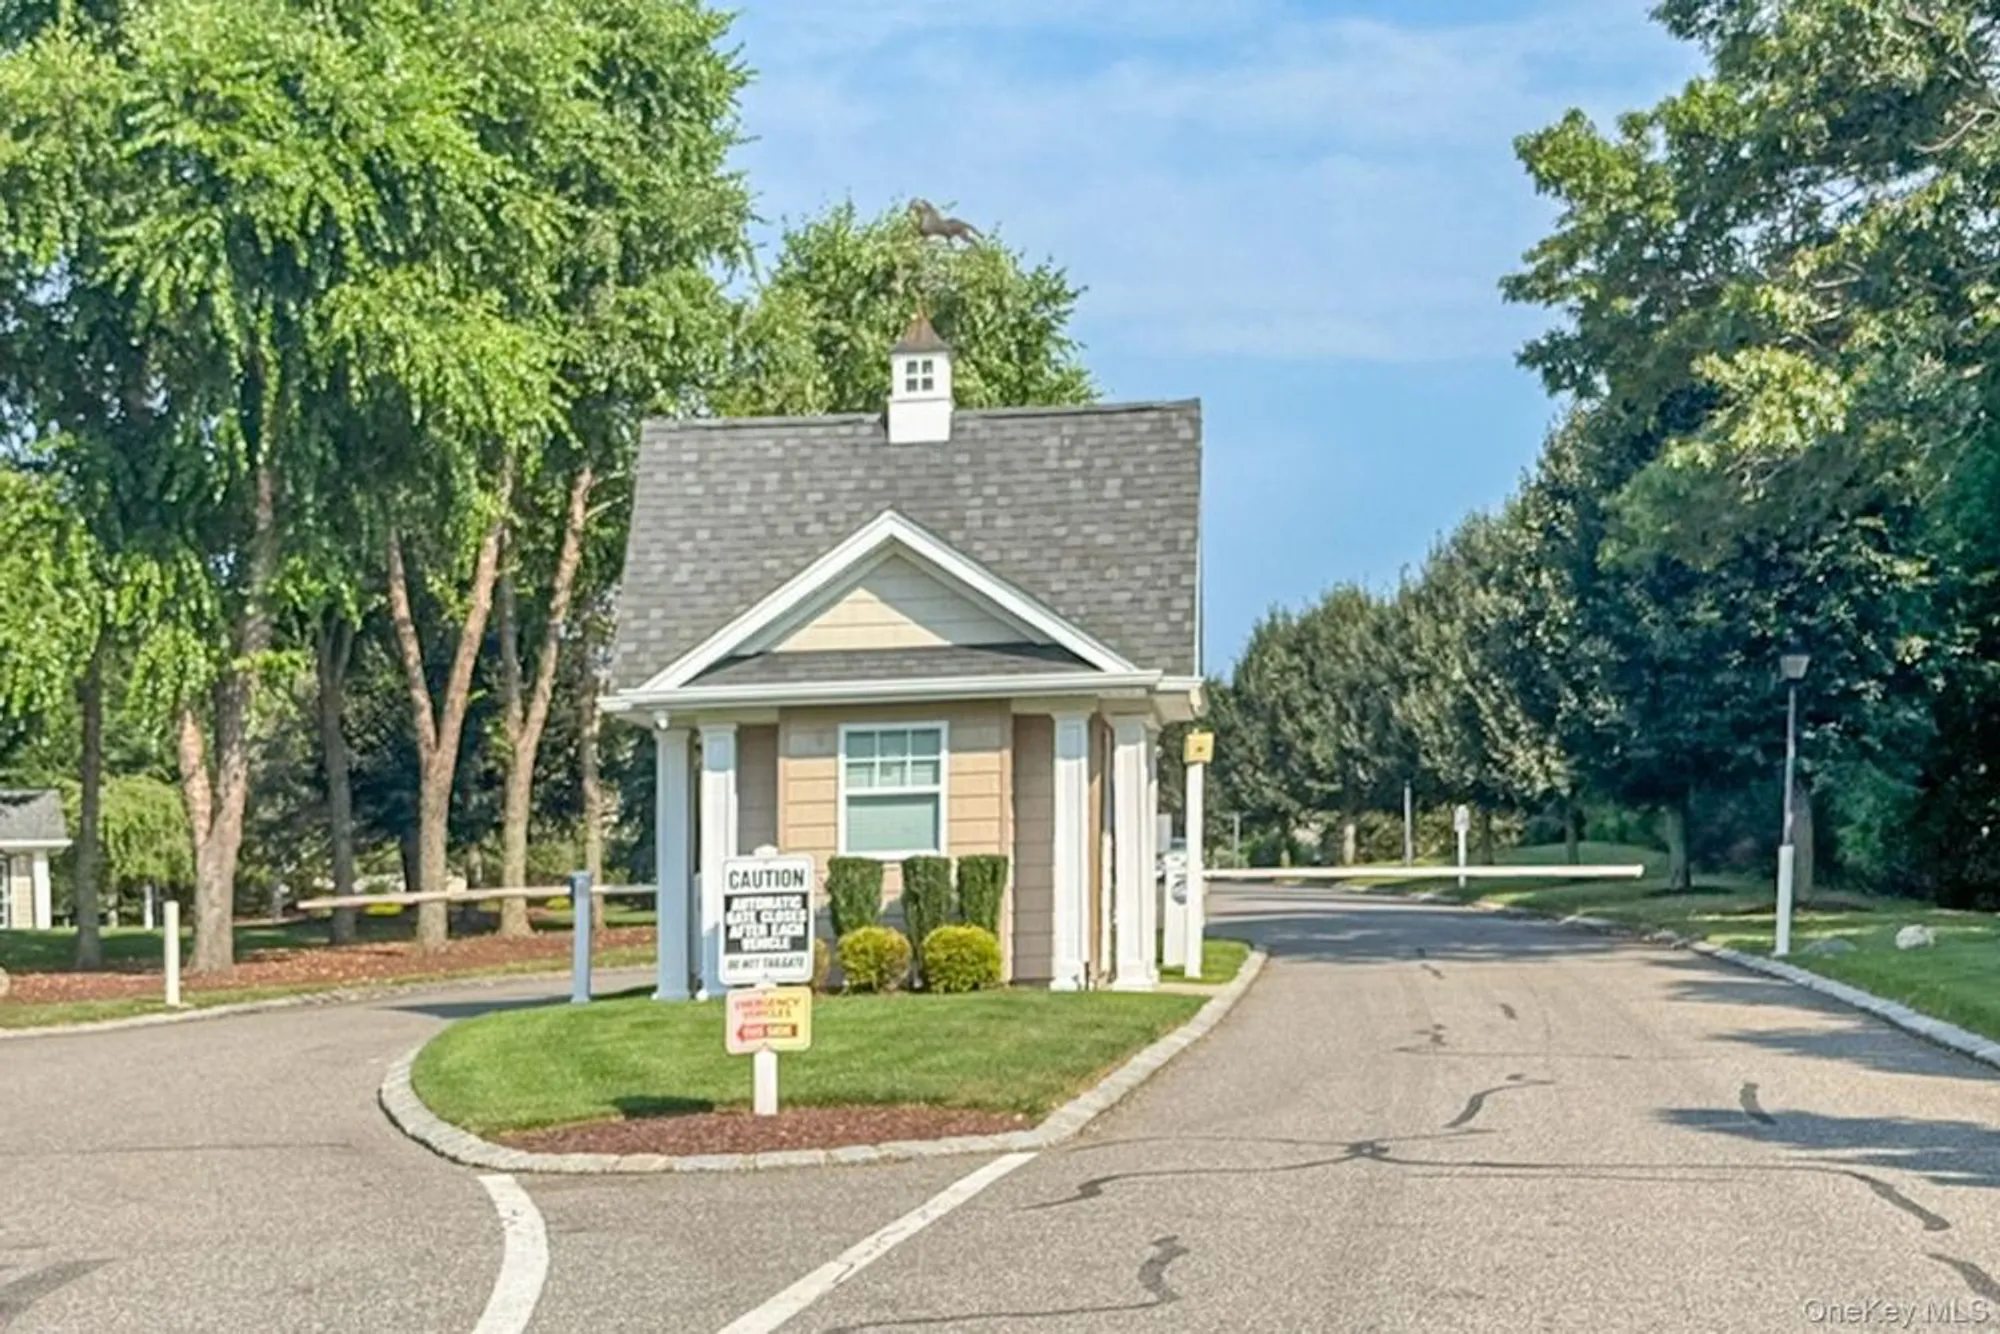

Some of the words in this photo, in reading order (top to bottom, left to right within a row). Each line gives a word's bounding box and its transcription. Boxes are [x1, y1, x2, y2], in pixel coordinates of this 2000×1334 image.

[729, 868, 805, 889] CAUTION
[731, 896, 802, 911] AUTOMATIC
[726, 910, 756, 925] GATE
[760, 908, 807, 923] CLOSES
[728, 923, 767, 939] AFTER
[770, 922, 805, 936] EACH
[741, 936, 790, 951] VEHICLE
